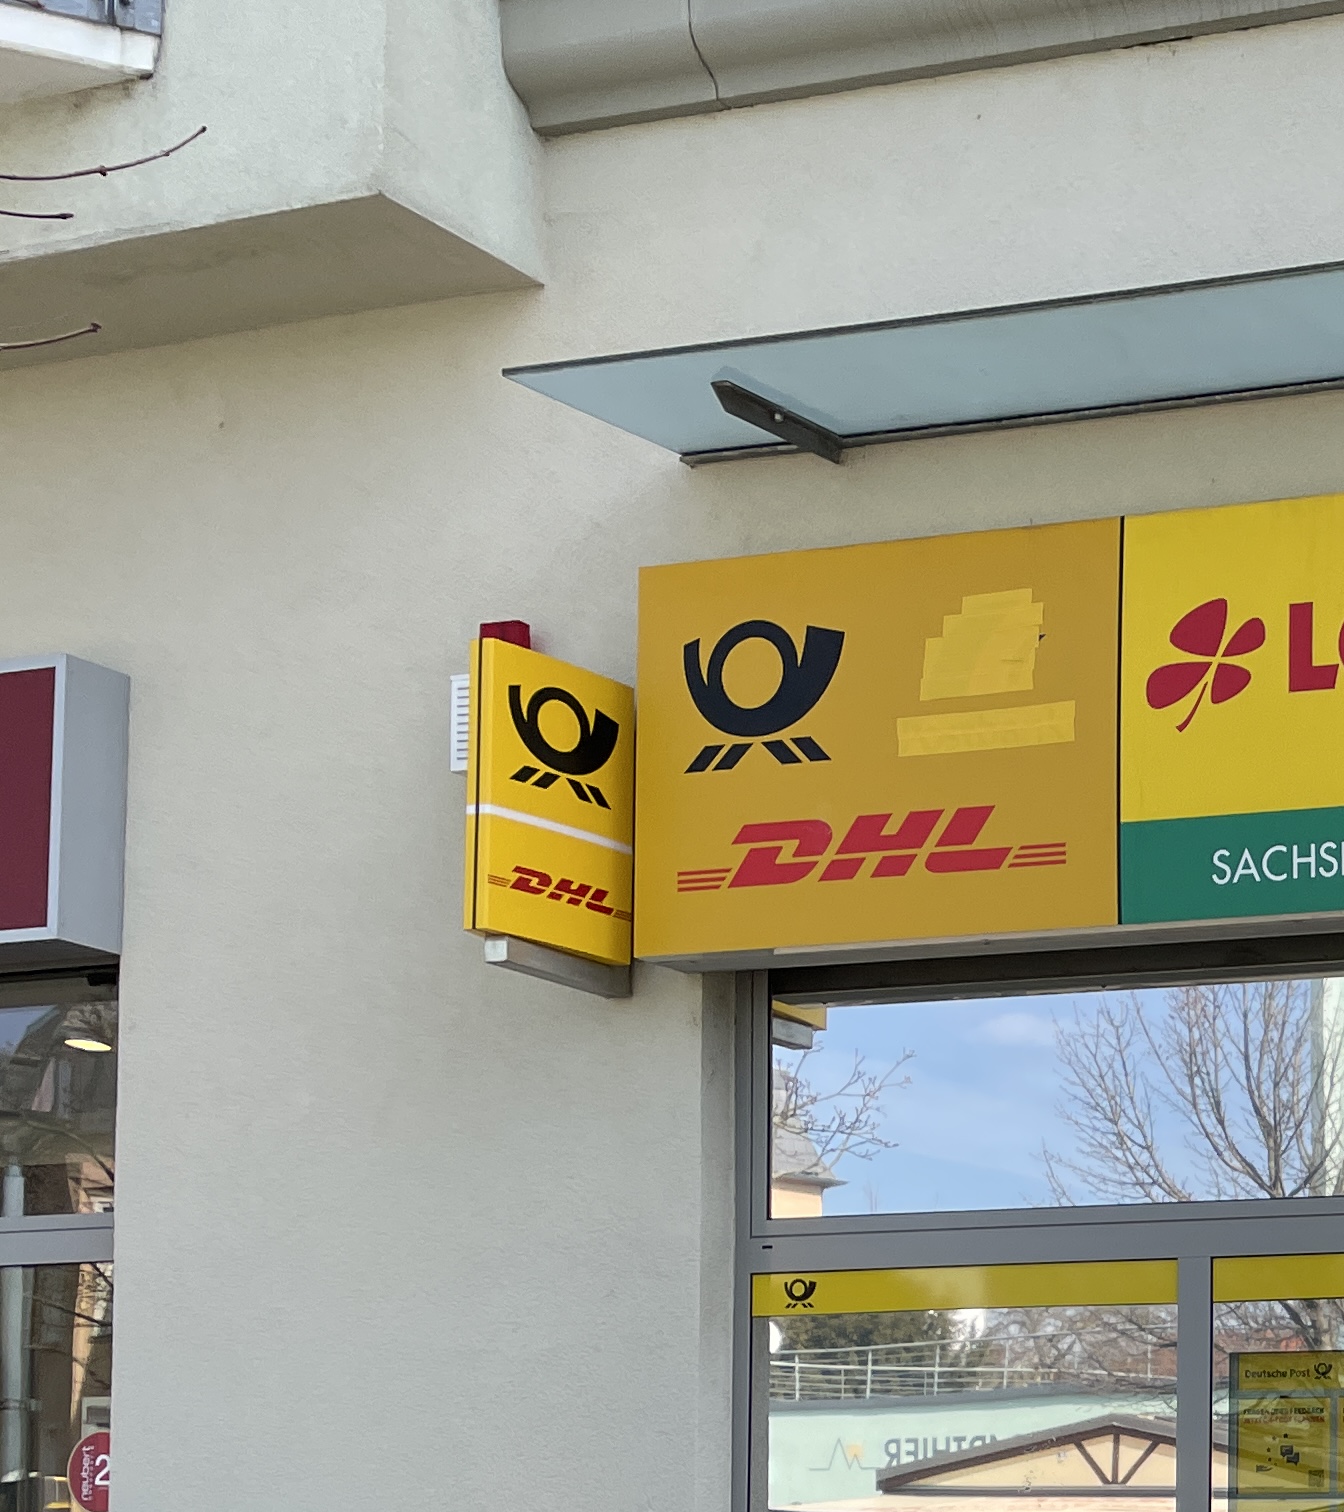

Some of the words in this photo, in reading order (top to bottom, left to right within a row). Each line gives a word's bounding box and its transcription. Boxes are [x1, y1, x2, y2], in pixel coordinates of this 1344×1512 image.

[727, 805, 1013, 889] DHL
[508, 865, 615, 915] DHL
[1245, 1369, 1287, 1378] Deutsche
[1290, 1368, 1310, 1377] Post
